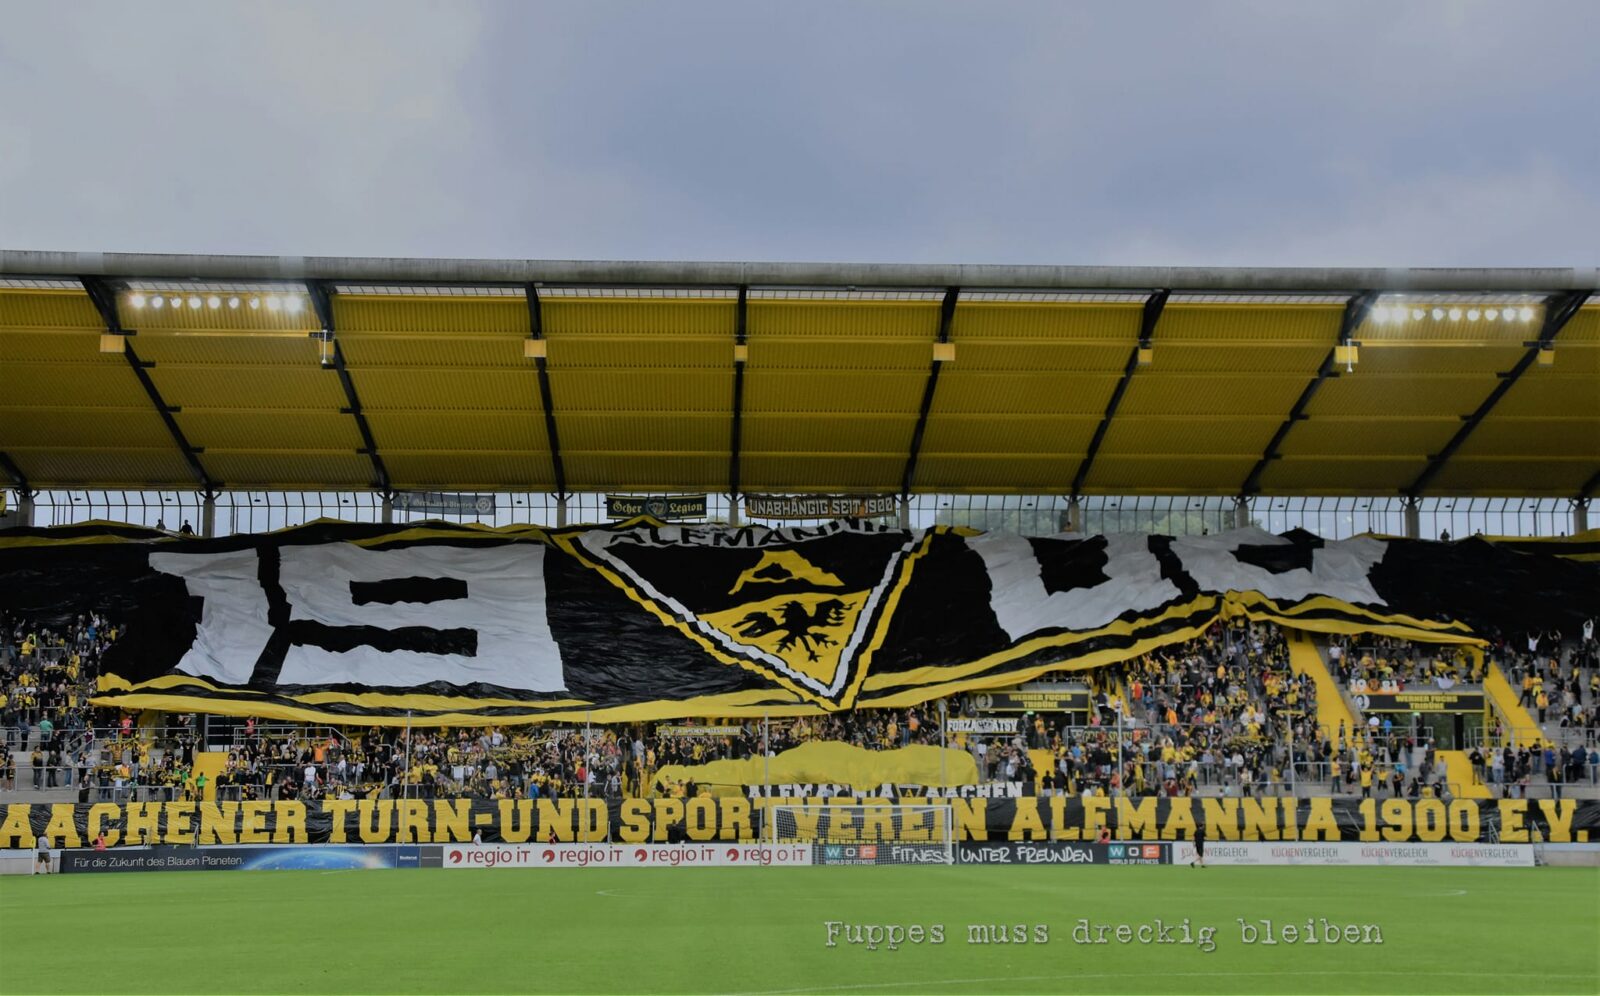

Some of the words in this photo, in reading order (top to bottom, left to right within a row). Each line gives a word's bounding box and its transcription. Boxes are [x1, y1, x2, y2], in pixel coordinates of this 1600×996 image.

[669, 503, 703, 514] Legion
[750, 498, 829, 515] UNABHÄNGIG
[832, 500, 861, 514] SEIT
[865, 498, 893, 513] 1900
[947, 720, 976, 732] FORZA
[926, 782, 1023, 798] AACHEN
[0, 800, 308, 848] AACHENER
[1007, 797, 1341, 841] ALEMANNIA
[1358, 798, 1481, 842] 1900
[74, 857, 89, 868] Für
[92, 857, 107, 867] die
[109, 856, 144, 867] Zukunft
[146, 856, 165, 867] des
[167, 855, 200, 866] Blauen
[202, 855, 245, 866] Planeten.
[467, 847, 512, 867] regio
[560, 846, 605, 866] regio
[652, 845, 697, 865] regio
[744, 846, 788, 865] rego
[891, 846, 955, 863] FITNESS
[960, 848, 1011, 864] UNTER
[1016, 846, 1092, 864] FREUNDEN
